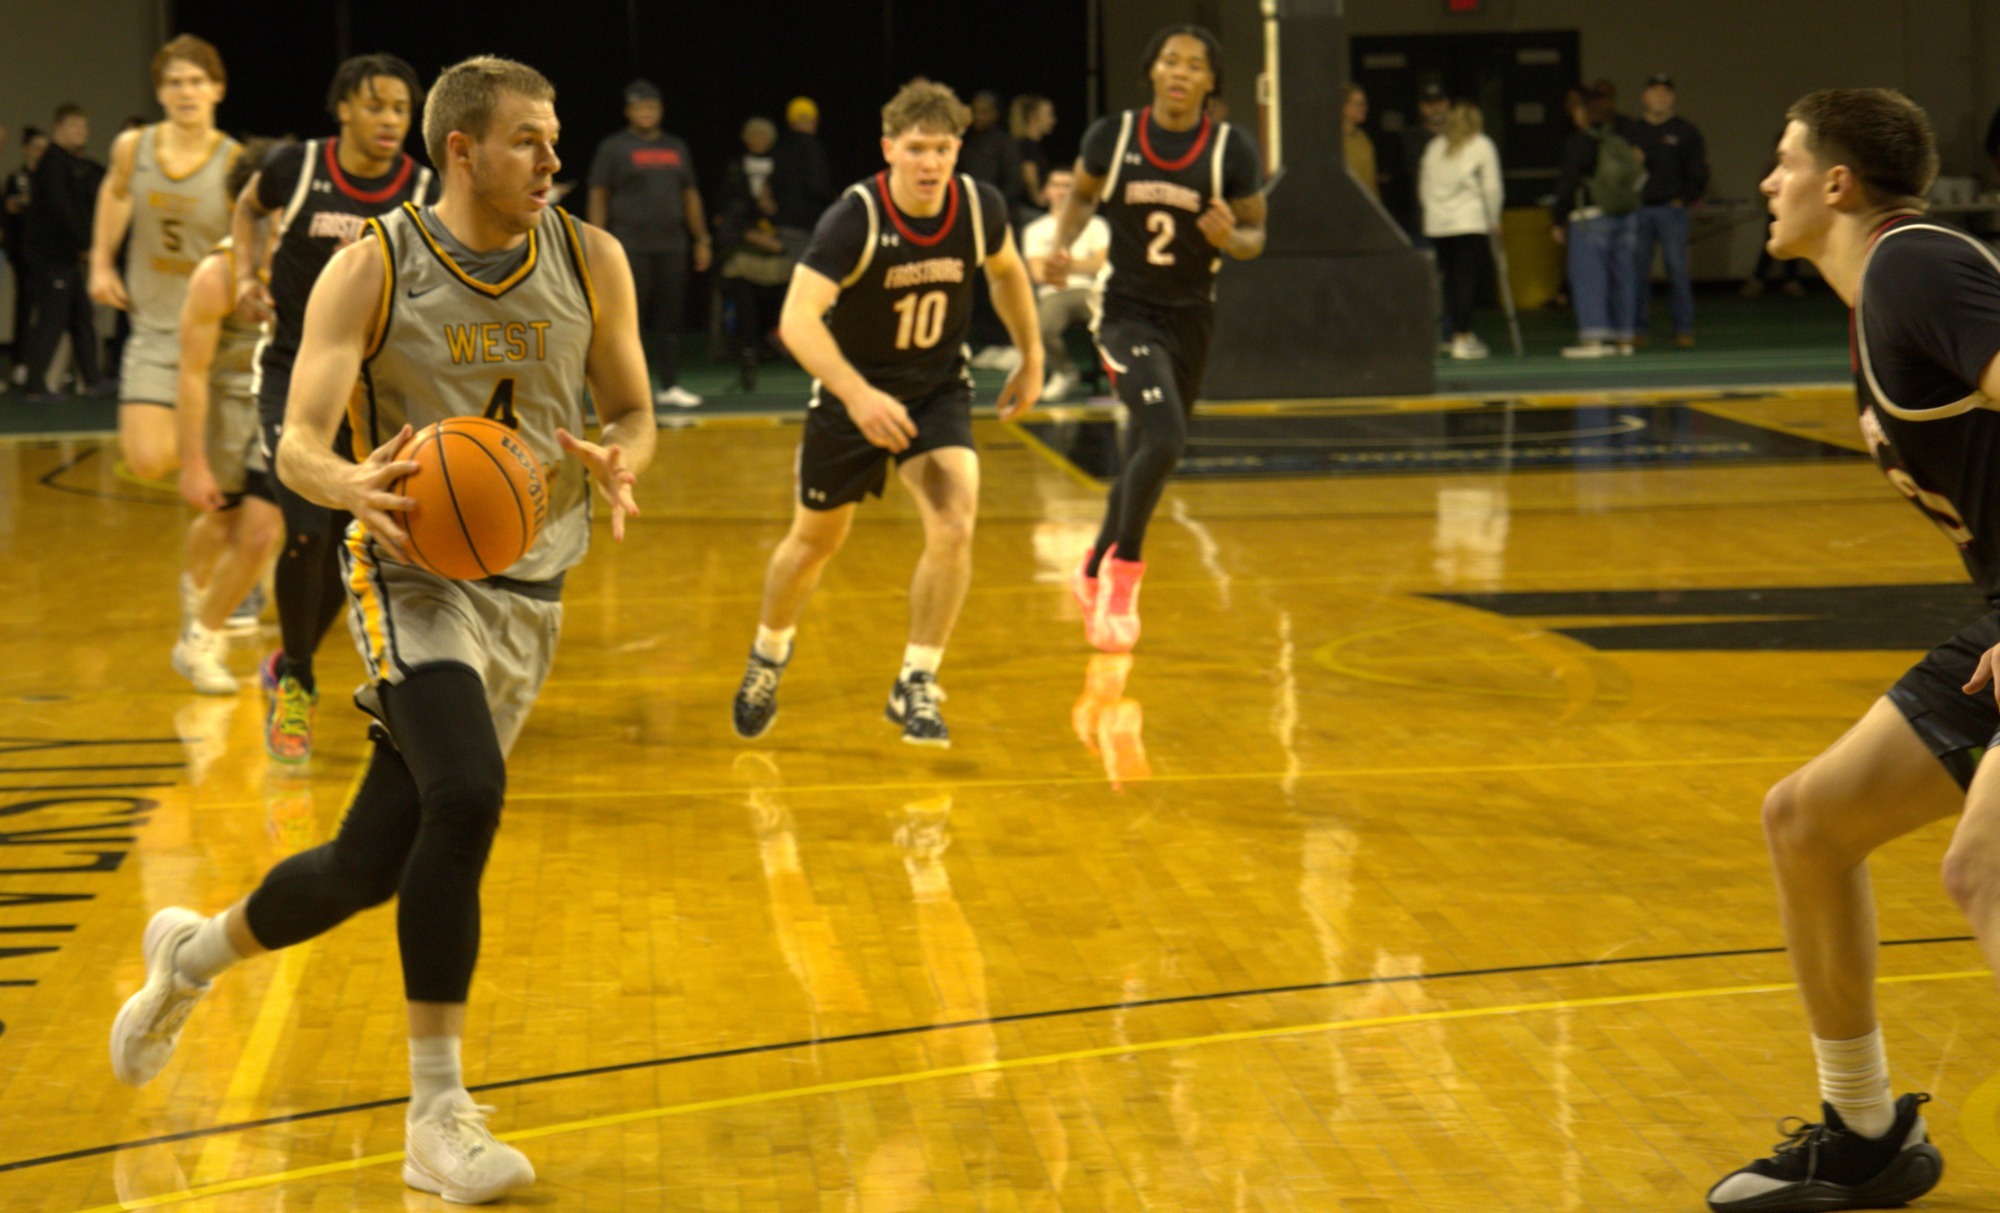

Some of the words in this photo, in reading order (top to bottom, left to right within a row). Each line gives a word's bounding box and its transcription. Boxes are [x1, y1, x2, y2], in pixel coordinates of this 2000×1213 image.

[163, 220, 183, 252] 5
[1146, 210, 1177, 267] 2
[884, 257, 965, 289] FROSTBURG
[444, 320, 553, 365] WEST
[893, 291, 949, 350] 10
[482, 376, 519, 430] 4
